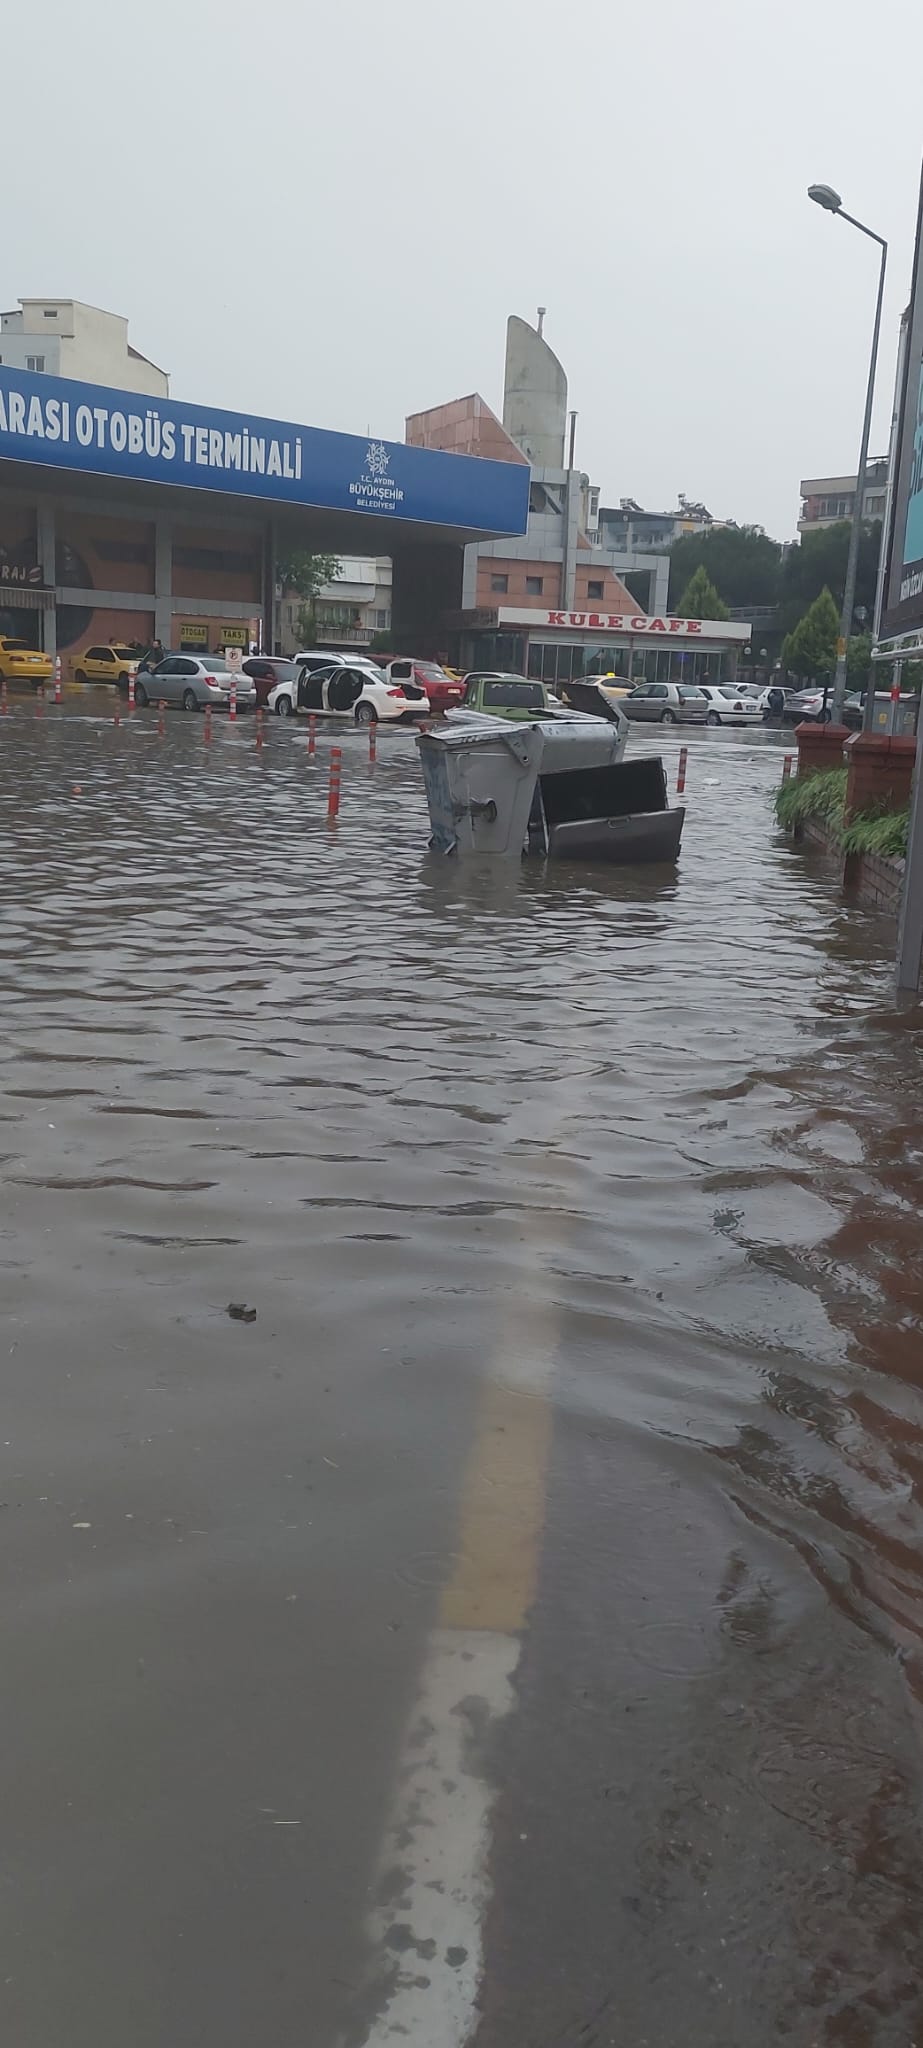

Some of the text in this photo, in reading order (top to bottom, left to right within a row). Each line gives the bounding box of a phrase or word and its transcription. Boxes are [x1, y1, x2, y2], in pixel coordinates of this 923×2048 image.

[75, 405, 175, 460] OTOBÜS
[181, 424, 302, 480] TERMİNALİ
[373, 477, 395, 486] AYDIN
[349, 482, 404, 501] BÜYÜKŞEHİR
[356, 498, 395, 510] BELEDİYESİ
[548, 612, 702, 633] KULE CAFE
